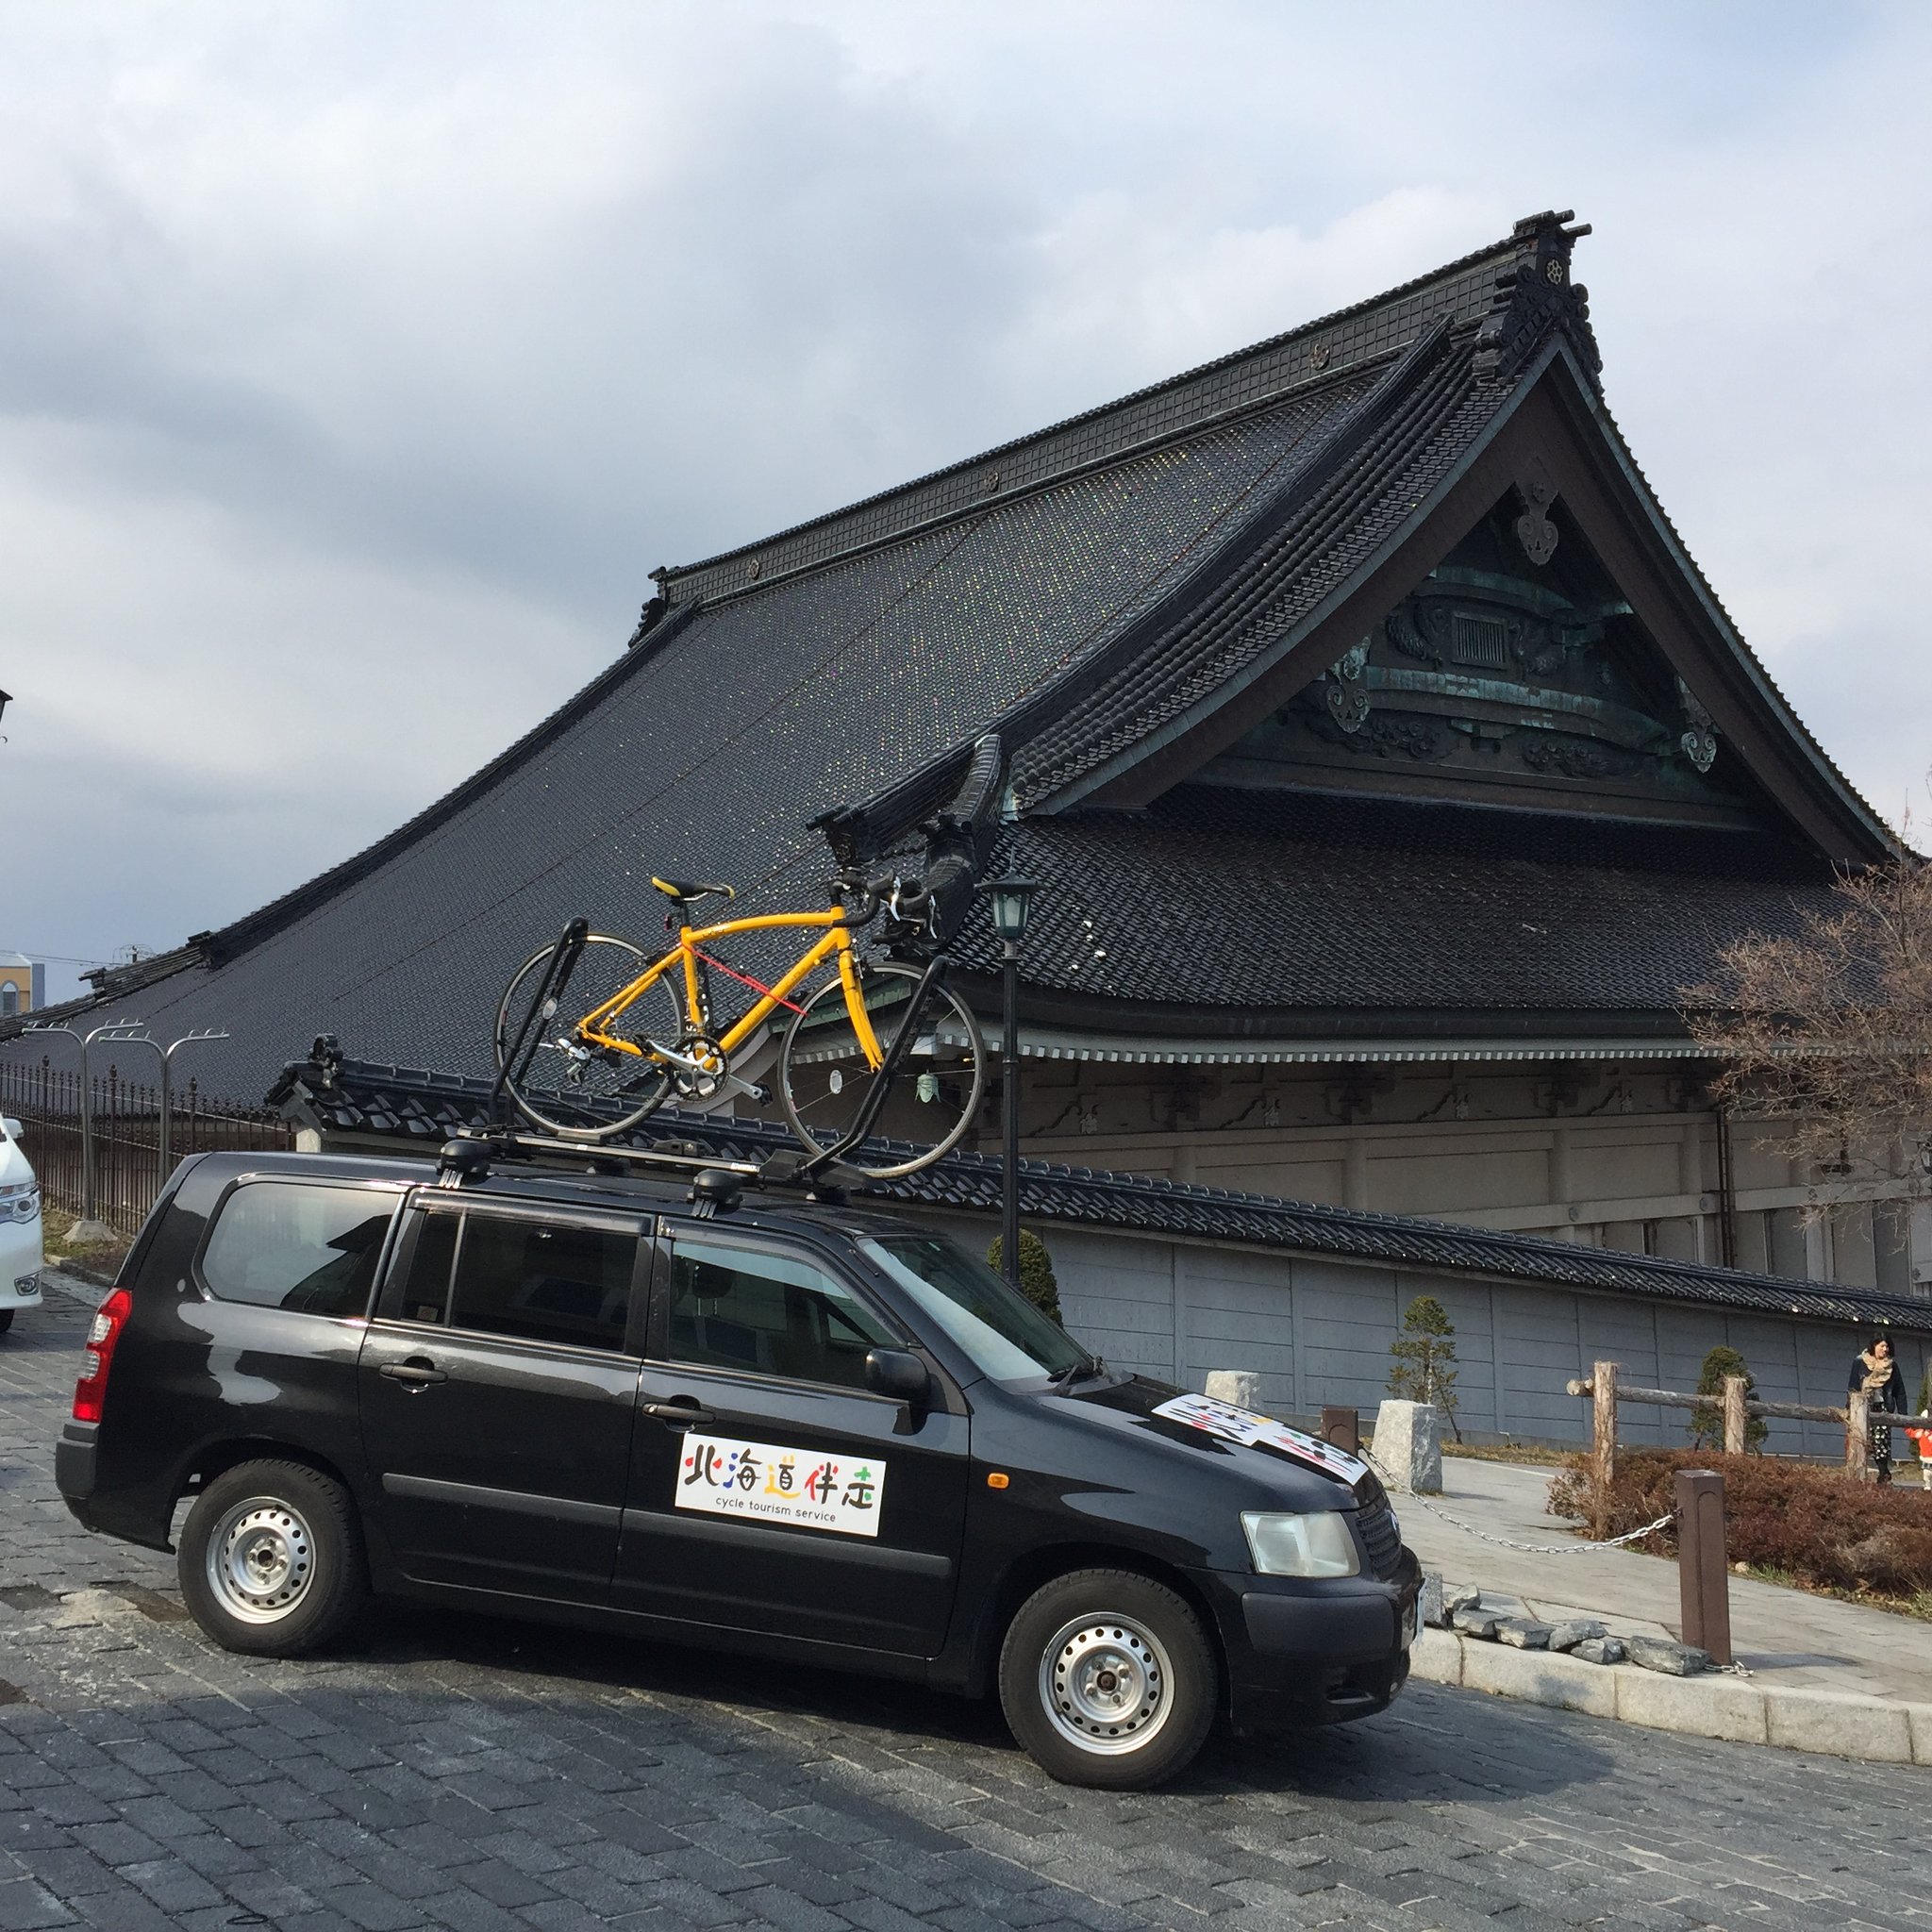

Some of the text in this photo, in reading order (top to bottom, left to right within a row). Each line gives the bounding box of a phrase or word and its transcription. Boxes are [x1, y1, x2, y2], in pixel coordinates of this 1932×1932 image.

[684, 1444, 875, 1509] 北海道伴走
[715, 1495, 836, 1523] cycle tourism service
